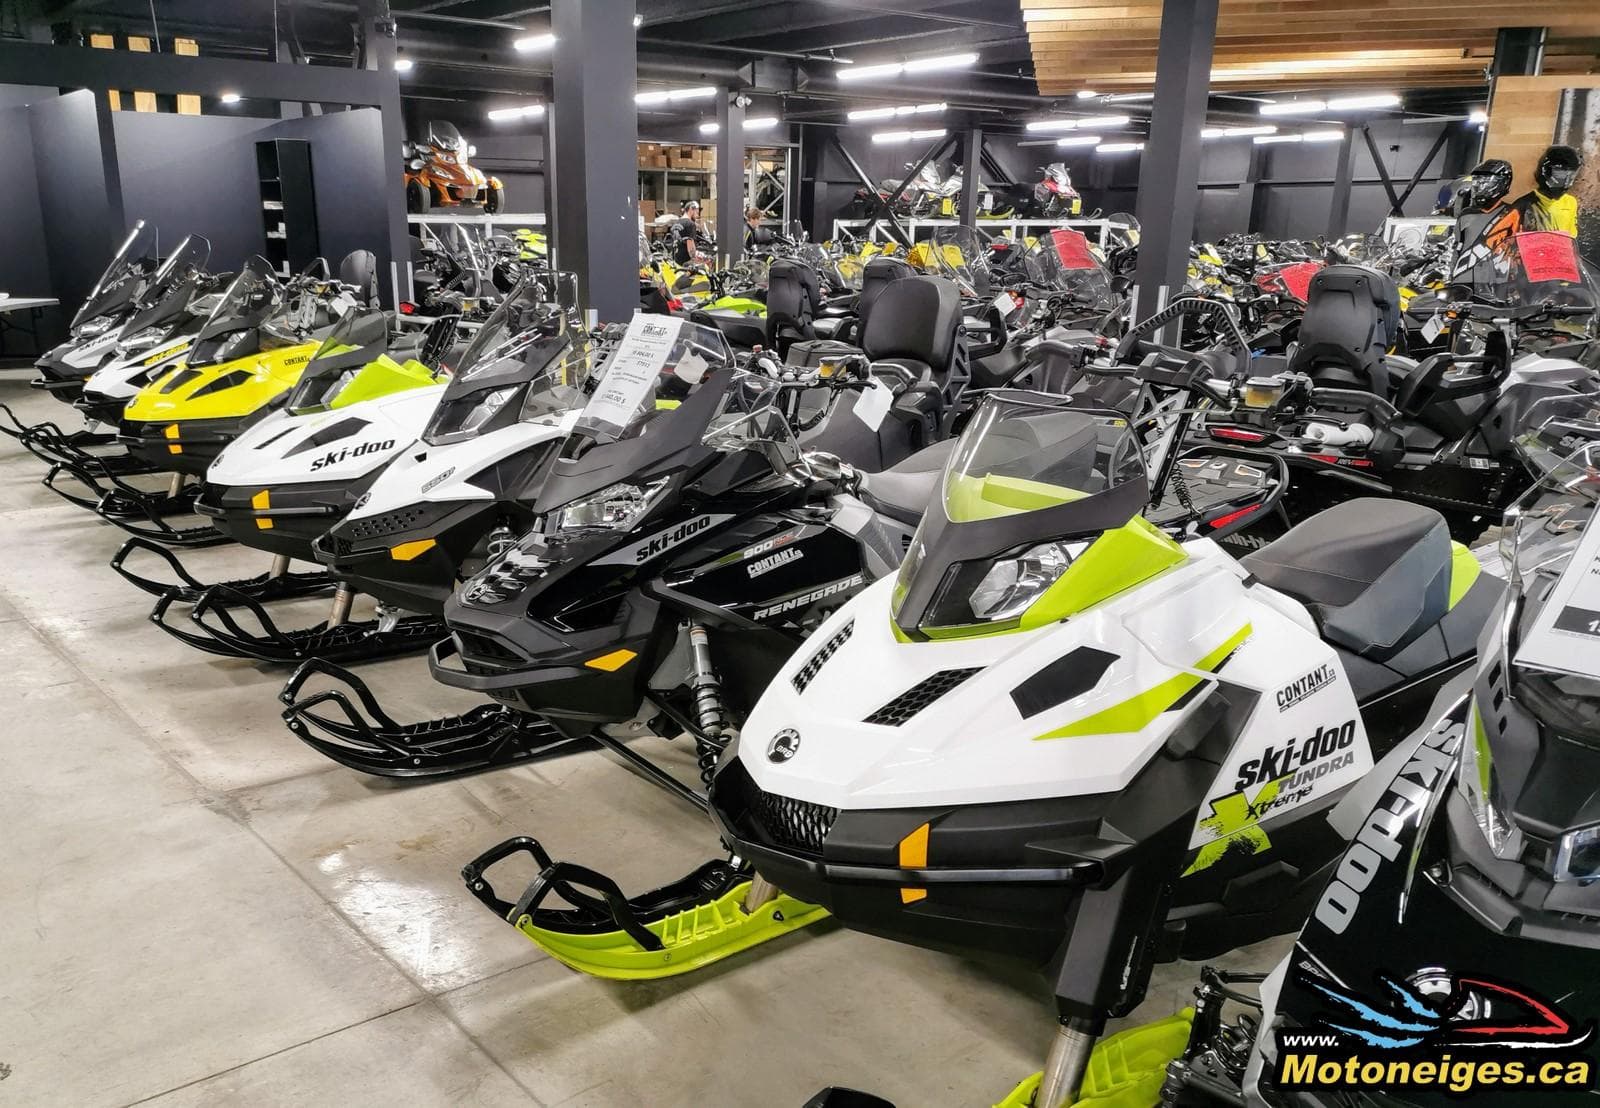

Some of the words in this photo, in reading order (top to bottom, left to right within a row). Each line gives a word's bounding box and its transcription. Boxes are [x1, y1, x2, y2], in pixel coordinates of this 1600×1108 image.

[310, 439, 395, 472] ski-doo
[636, 515, 711, 562] ski-doo
[754, 576, 864, 621] RENEGADE
[1235, 719, 1356, 791] ski-doo
[1279, 751, 1354, 793] TUNDRA
[1245, 783, 1313, 820] Xtreme
